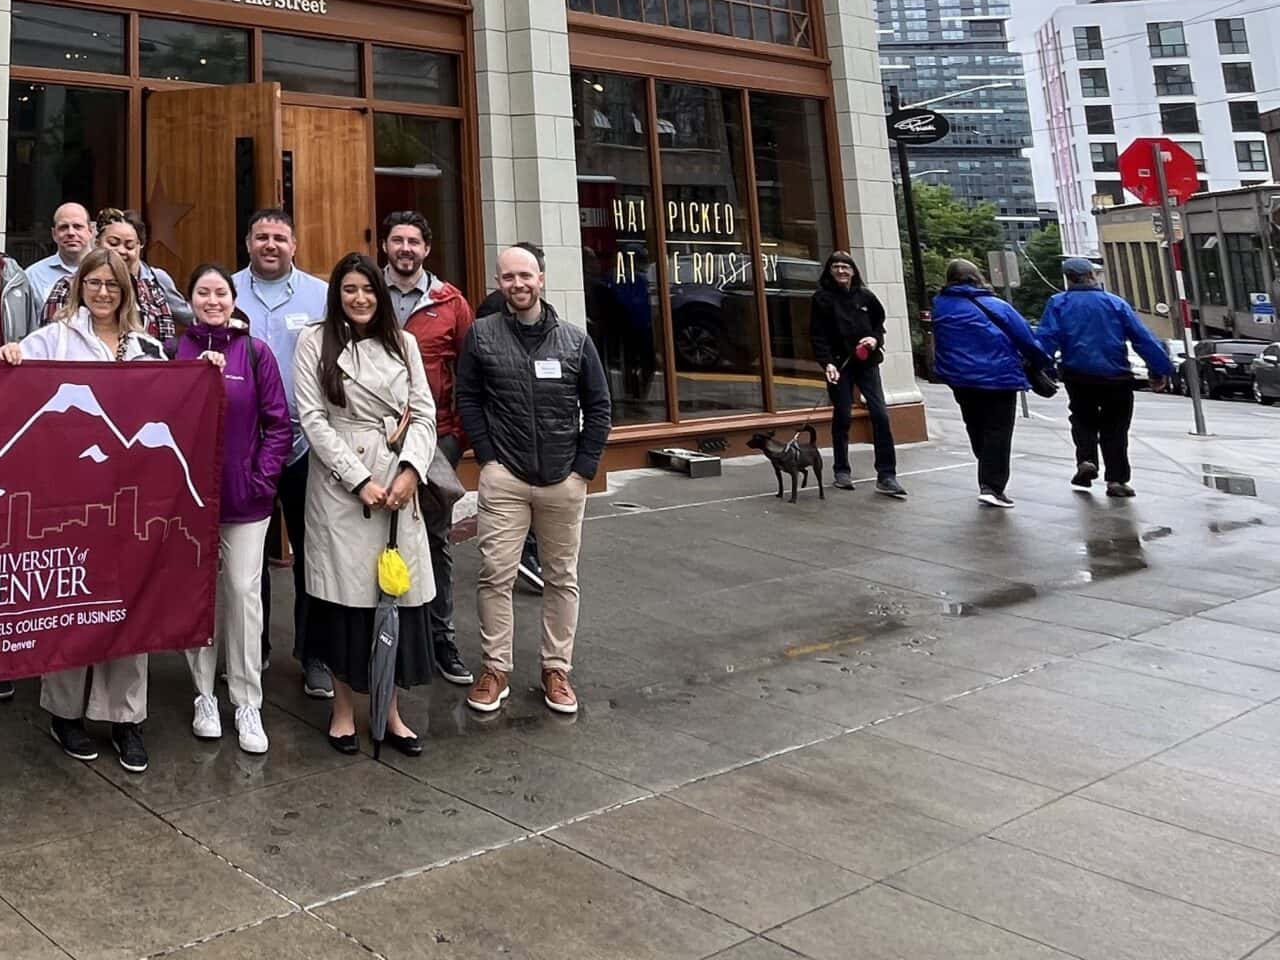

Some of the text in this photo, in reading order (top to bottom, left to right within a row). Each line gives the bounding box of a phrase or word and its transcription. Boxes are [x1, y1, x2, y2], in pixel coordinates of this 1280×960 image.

[668, 201, 734, 235] PICKED
[617, 251, 637, 285] AT
[693, 251, 778, 285] ROASTRY
[77, 548, 90, 564] of
[15, 615, 58, 634] COLLEGE
[60, 613, 74, 627] OF
[77, 608, 127, 625] BUSINESS
[2, 639, 37, 652] Denver
